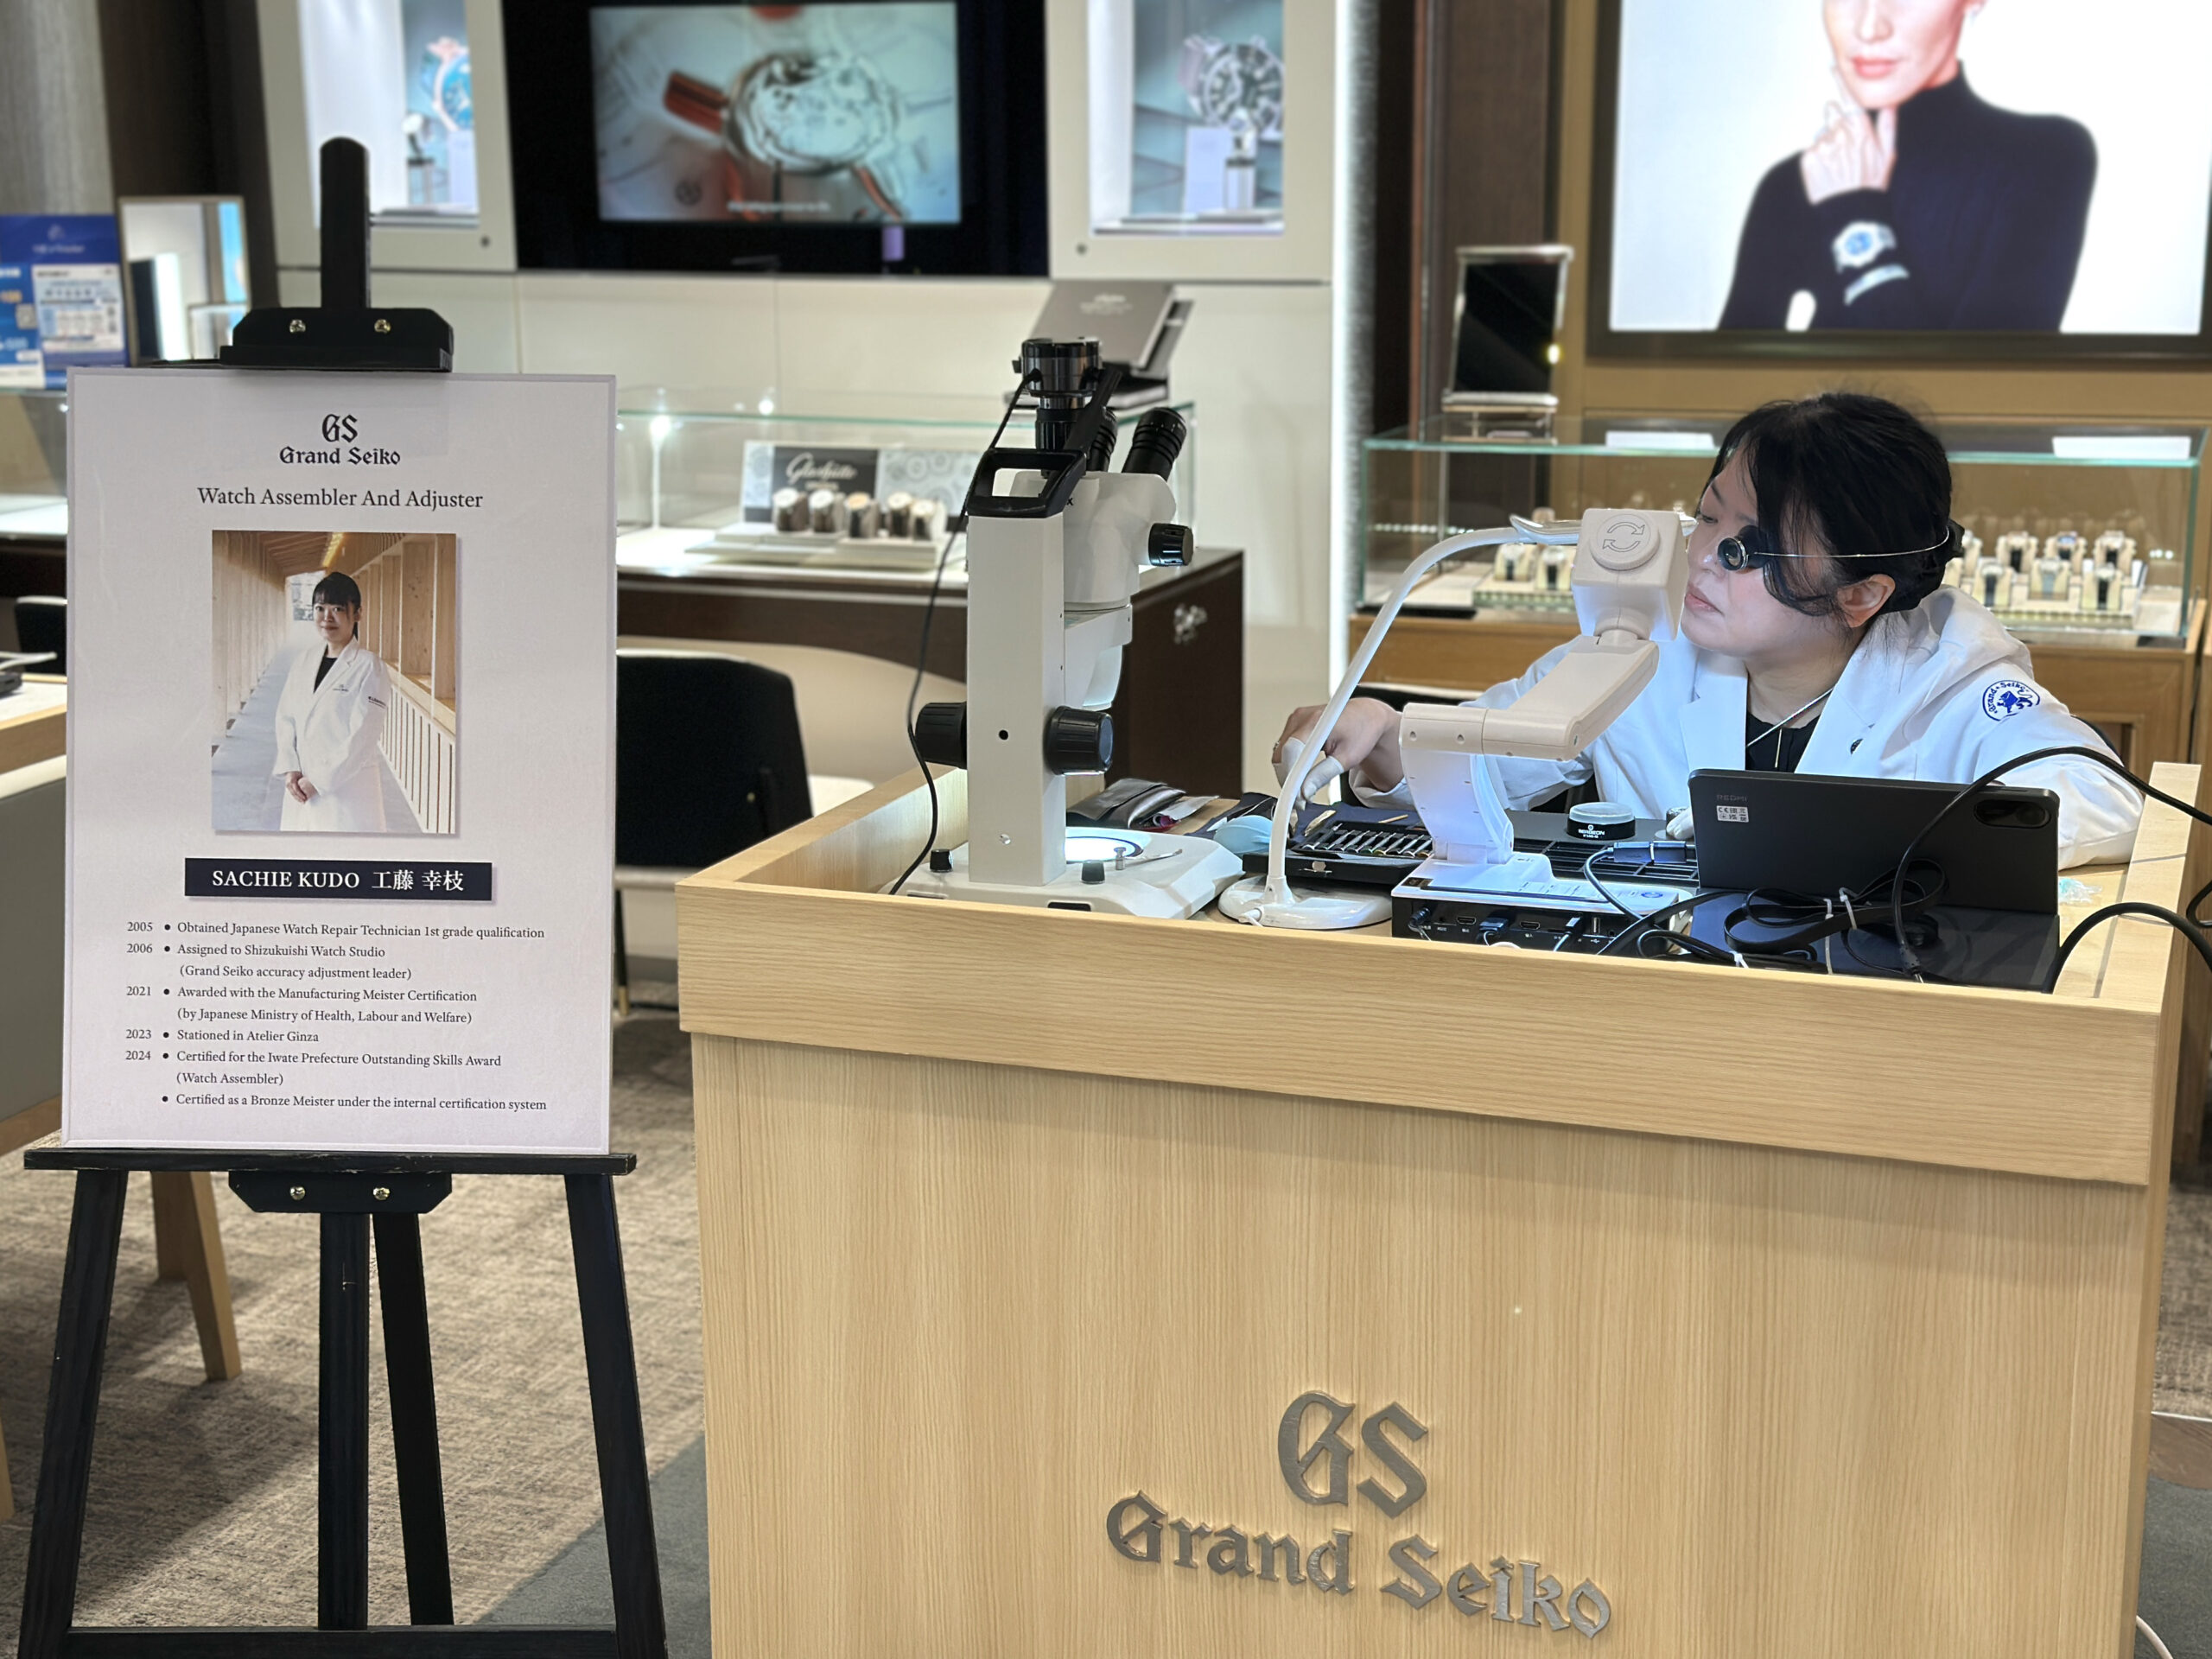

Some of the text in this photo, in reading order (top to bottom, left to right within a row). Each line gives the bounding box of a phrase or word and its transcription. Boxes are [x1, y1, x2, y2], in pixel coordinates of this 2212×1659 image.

[322, 414, 358, 442] GS
[280, 446, 400, 465] Grand Seiko
[198, 487, 483, 511] Watch Assembler And Adjuster
[213, 871, 359, 887] SACHIE KUDO
[372, 870, 463, 891] 工藤 幸枝
[128, 922, 544, 940] 2005 Obtained Japanese Watch Repair Technician 1st grade qualification
[127, 944, 152, 953] 2006
[177, 944, 227, 957] Assigned
[245, 944, 308, 956] Shizukuishi
[311, 946, 346, 956] Watch
[349, 946, 385, 957] Studio
[181, 965, 411, 980] (Grand Seiko accuracy adjustment leader)
[127, 986, 476, 1002] 2021 Awarded with the Manufacturing Meister Certification
[178, 1008, 472, 1024] (by Japanese Ministry of Health, Labour and Welfare)
[126, 1029, 318, 1041] 2023 Stationed in Atelier Ginza
[126, 1051, 501, 1068] 2024 Certified for the Iwate Prefecture Outstanding Skills Award
[177, 1072, 283, 1085] (Watch Assembler)
[176, 1094, 225, 1104] Certified
[251, 1096, 289, 1105] Bronze
[294, 1096, 334, 1106] Meister
[338, 1096, 370, 1106] under
[373, 1096, 391, 1107] the
[394, 1097, 435, 1108] internal
[440, 1098, 505, 1109] certification
[509, 1102, 546, 1112] system
[1277, 1389, 1428, 1518] GS
[1106, 1489, 1611, 1638] Grand Seiko
